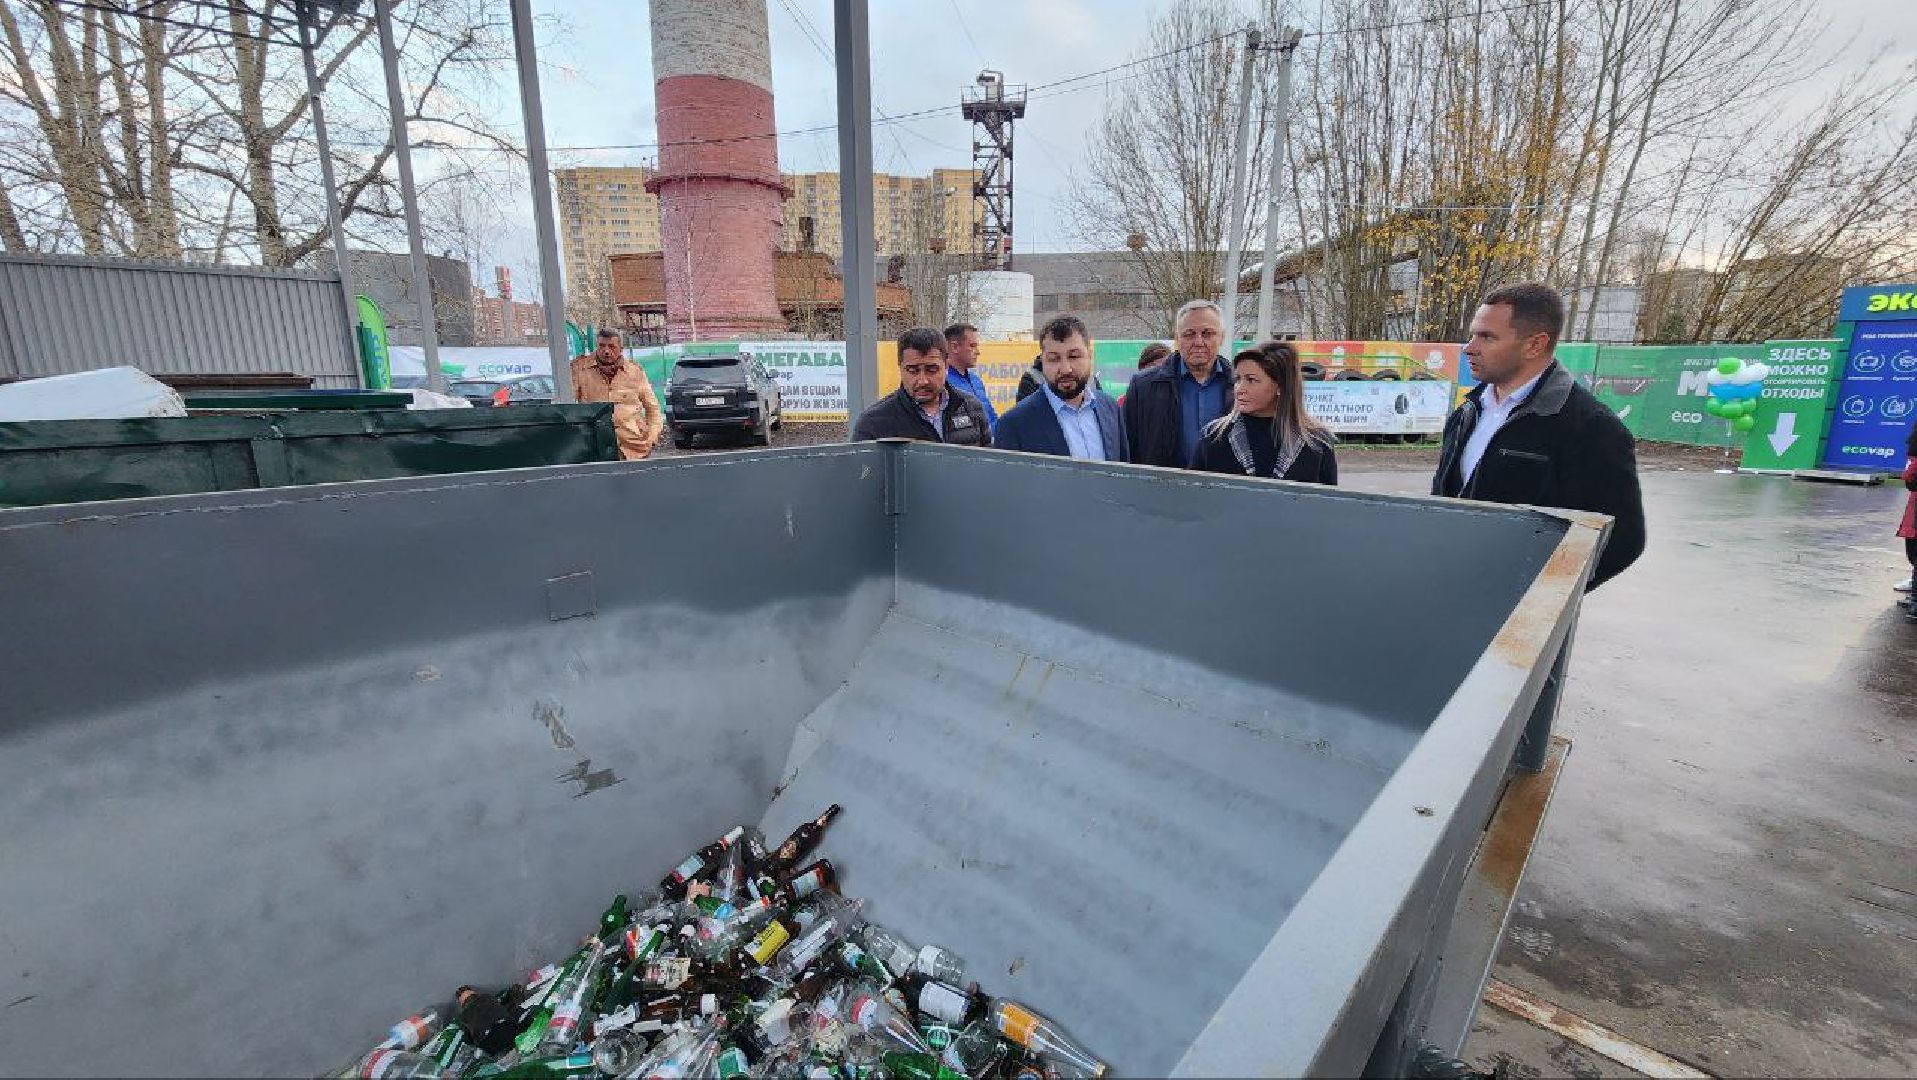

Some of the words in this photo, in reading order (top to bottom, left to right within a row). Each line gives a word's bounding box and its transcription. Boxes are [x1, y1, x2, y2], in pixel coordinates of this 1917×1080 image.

[1866, 292, 1917, 312] ЭК
[1768, 347, 1831, 362] ЗДЕСЬ
[1768, 365, 1829, 376] МОЖНО
[1677, 371, 1717, 396] М
[802, 385, 841, 397] ВЕЩАМ
[1761, 388, 1825, 399] ОТХОДЫ
[1842, 446, 1895, 458] ecovap
